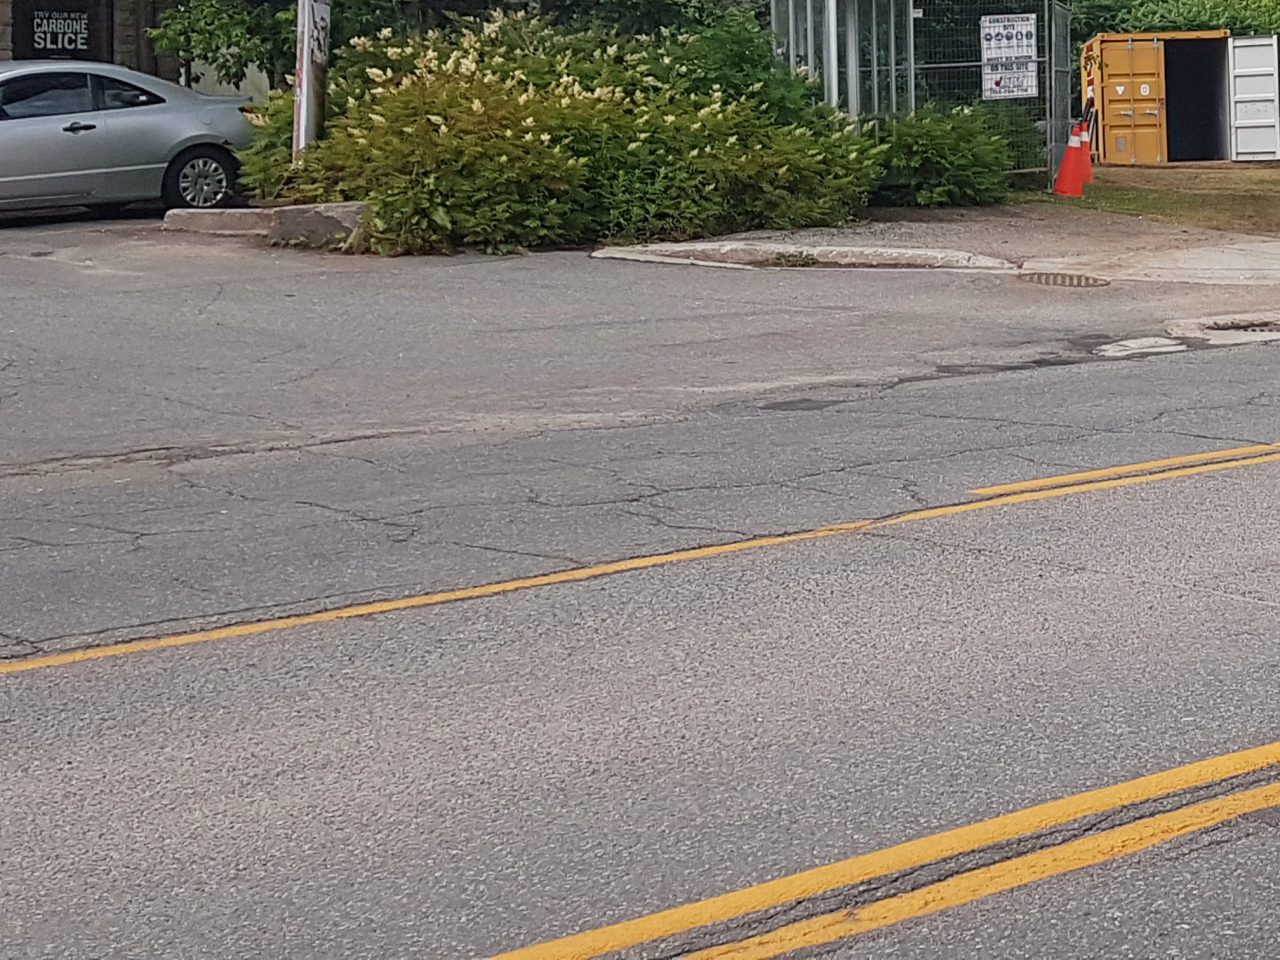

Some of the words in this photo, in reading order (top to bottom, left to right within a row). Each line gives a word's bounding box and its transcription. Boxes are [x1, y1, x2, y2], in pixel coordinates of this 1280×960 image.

[34, 10, 50, 19] TRY
[51, 11, 69, 19] OUR
[70, 11, 88, 20] NEW
[988, 16, 1031, 25] CONSTRUCTION
[33, 18, 89, 33] CARBONE
[33, 32, 89, 50] SLICE
